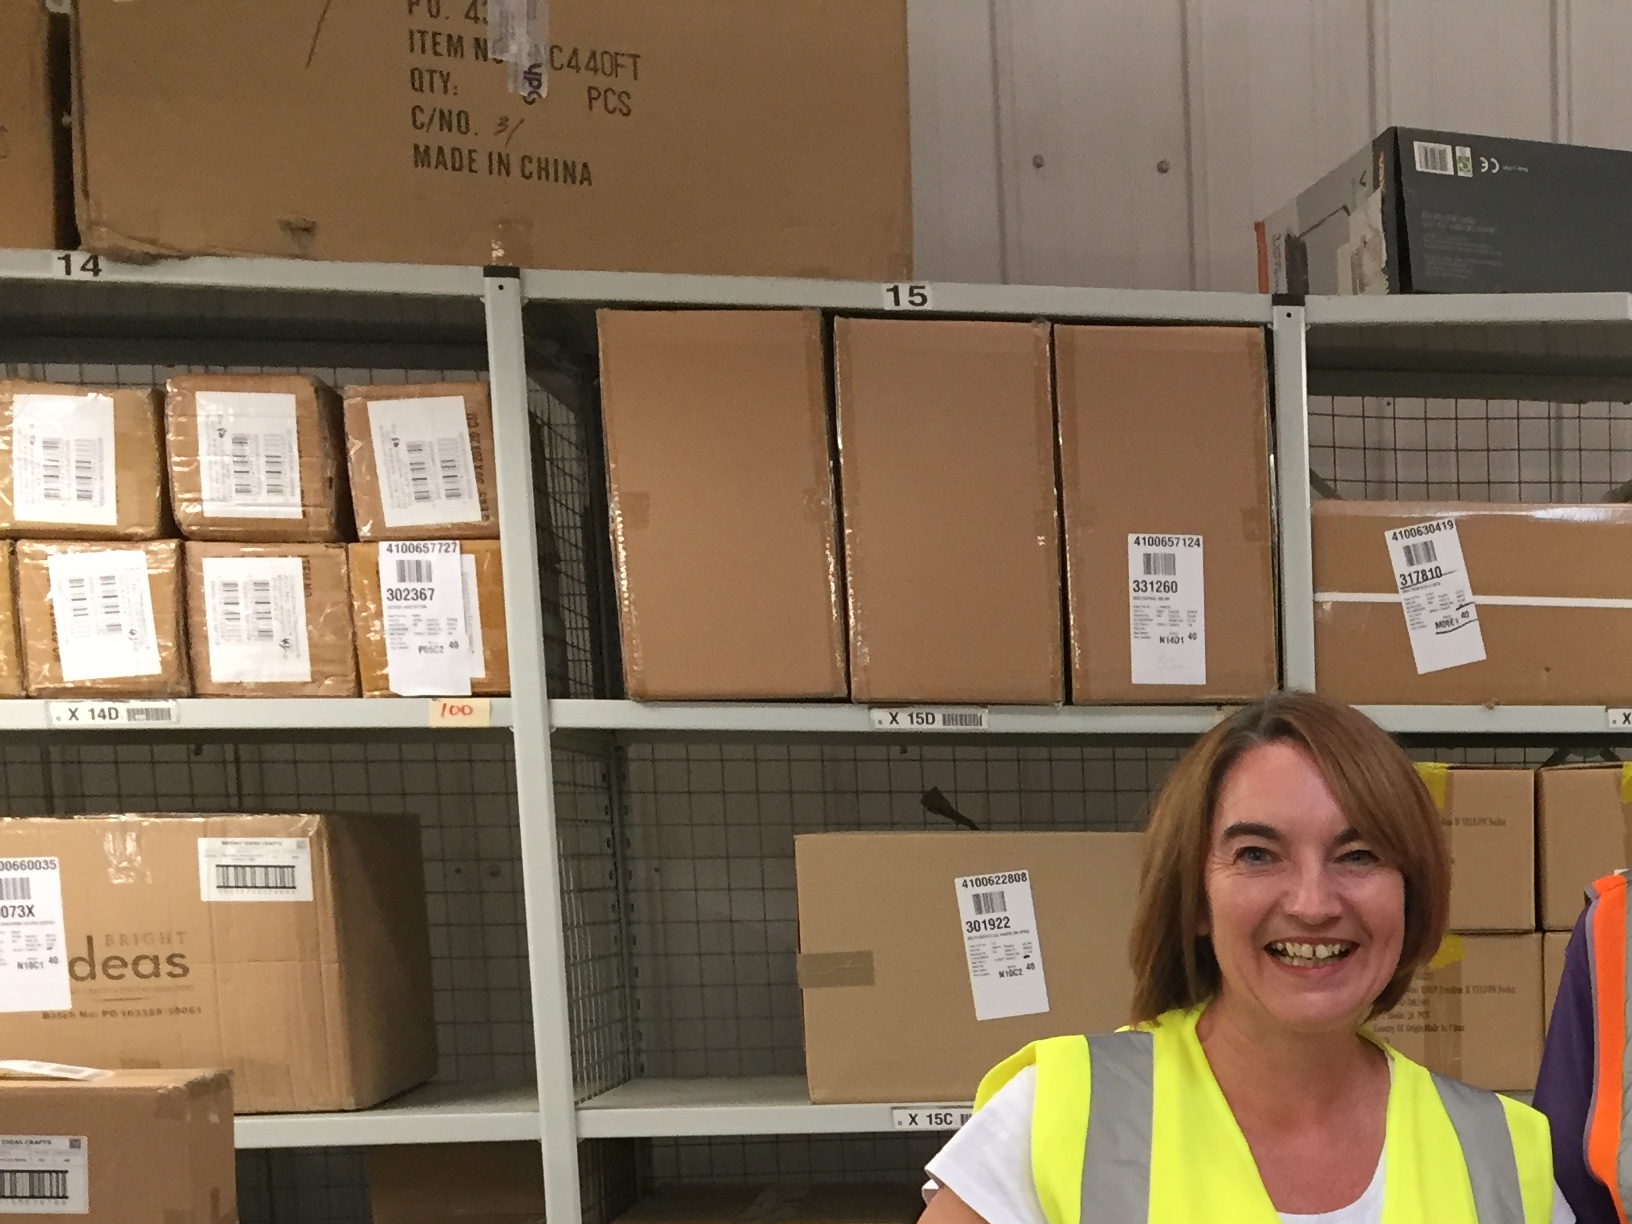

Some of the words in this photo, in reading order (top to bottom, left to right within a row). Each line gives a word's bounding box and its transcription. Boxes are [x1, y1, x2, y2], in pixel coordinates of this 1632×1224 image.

[408, 29, 464, 59] ITEM
[410, 67, 458, 95] QTY:
[587, 86, 632, 117] PCS
[413, 143, 478, 174] MADE
[488, 151, 511, 177] IN
[520, 155, 593, 187] CHINA
[56, 254, 103, 278] 14
[886, 284, 930, 308] 15
[1391, 519, 1454, 541] 4100630419
[386, 541, 458, 554] 4100657727
[1133, 536, 1201, 548] 4100657124
[1400, 566, 1443, 587] 317810
[386, 588, 435, 601] 302367
[1132, 580, 1178, 593] 331260
[67, 707, 80, 722] X
[88, 707, 120, 722] 14D
[440, 702, 474, 718] 100
[1622, 712, 1632, 724] X
[889, 712, 900, 725] X
[908, 712, 936, 725] 15D
[962, 872, 1028, 889] 4100622808
[966, 916, 1011, 934] 301922
[104, 931, 188, 947] BRIGHT
[68, 935, 190, 982] deas
[908, 1113, 919, 1126] X
[926, 1113, 953, 1126] 15C
